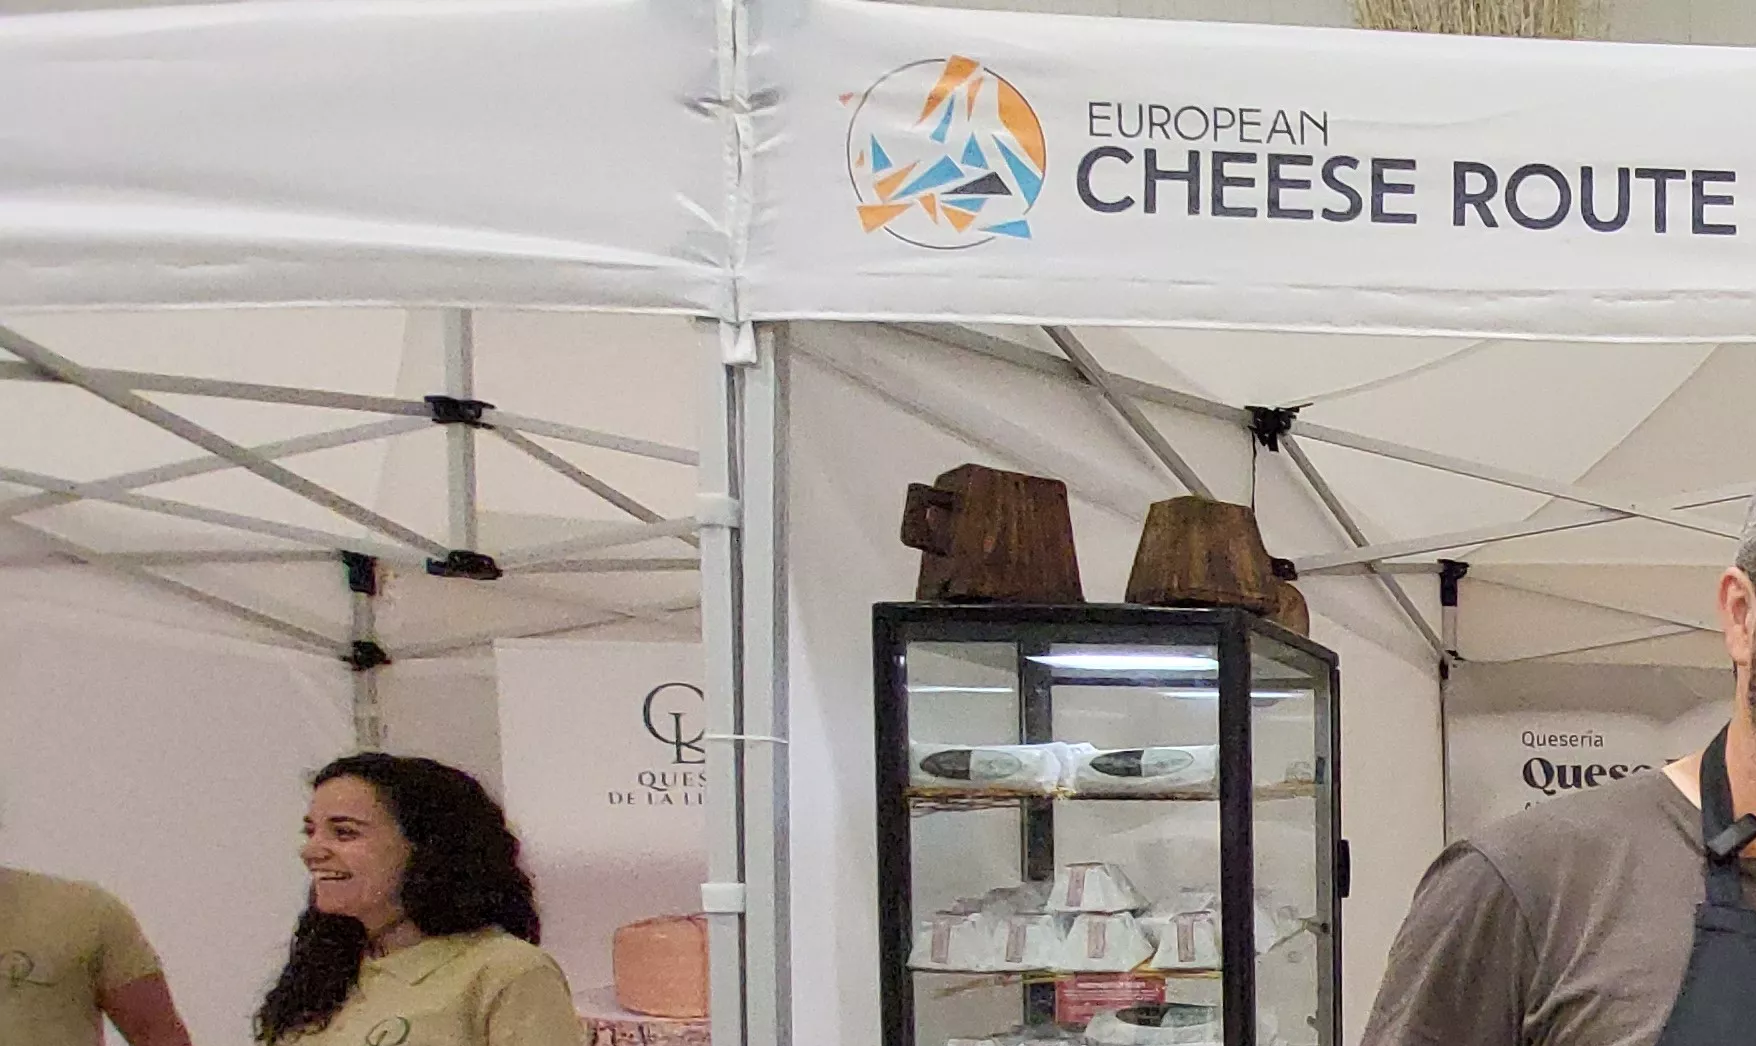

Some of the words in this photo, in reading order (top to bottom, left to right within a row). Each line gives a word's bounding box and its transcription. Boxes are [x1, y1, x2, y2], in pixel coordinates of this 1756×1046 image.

[1088, 101, 1330, 147] EUROPEAN
[1076, 146, 1418, 225] CHEESE
[1452, 162, 1737, 236] ROUTE
[1521, 729, 1604, 749] Quesería
[1522, 757, 1652, 796] Ques
